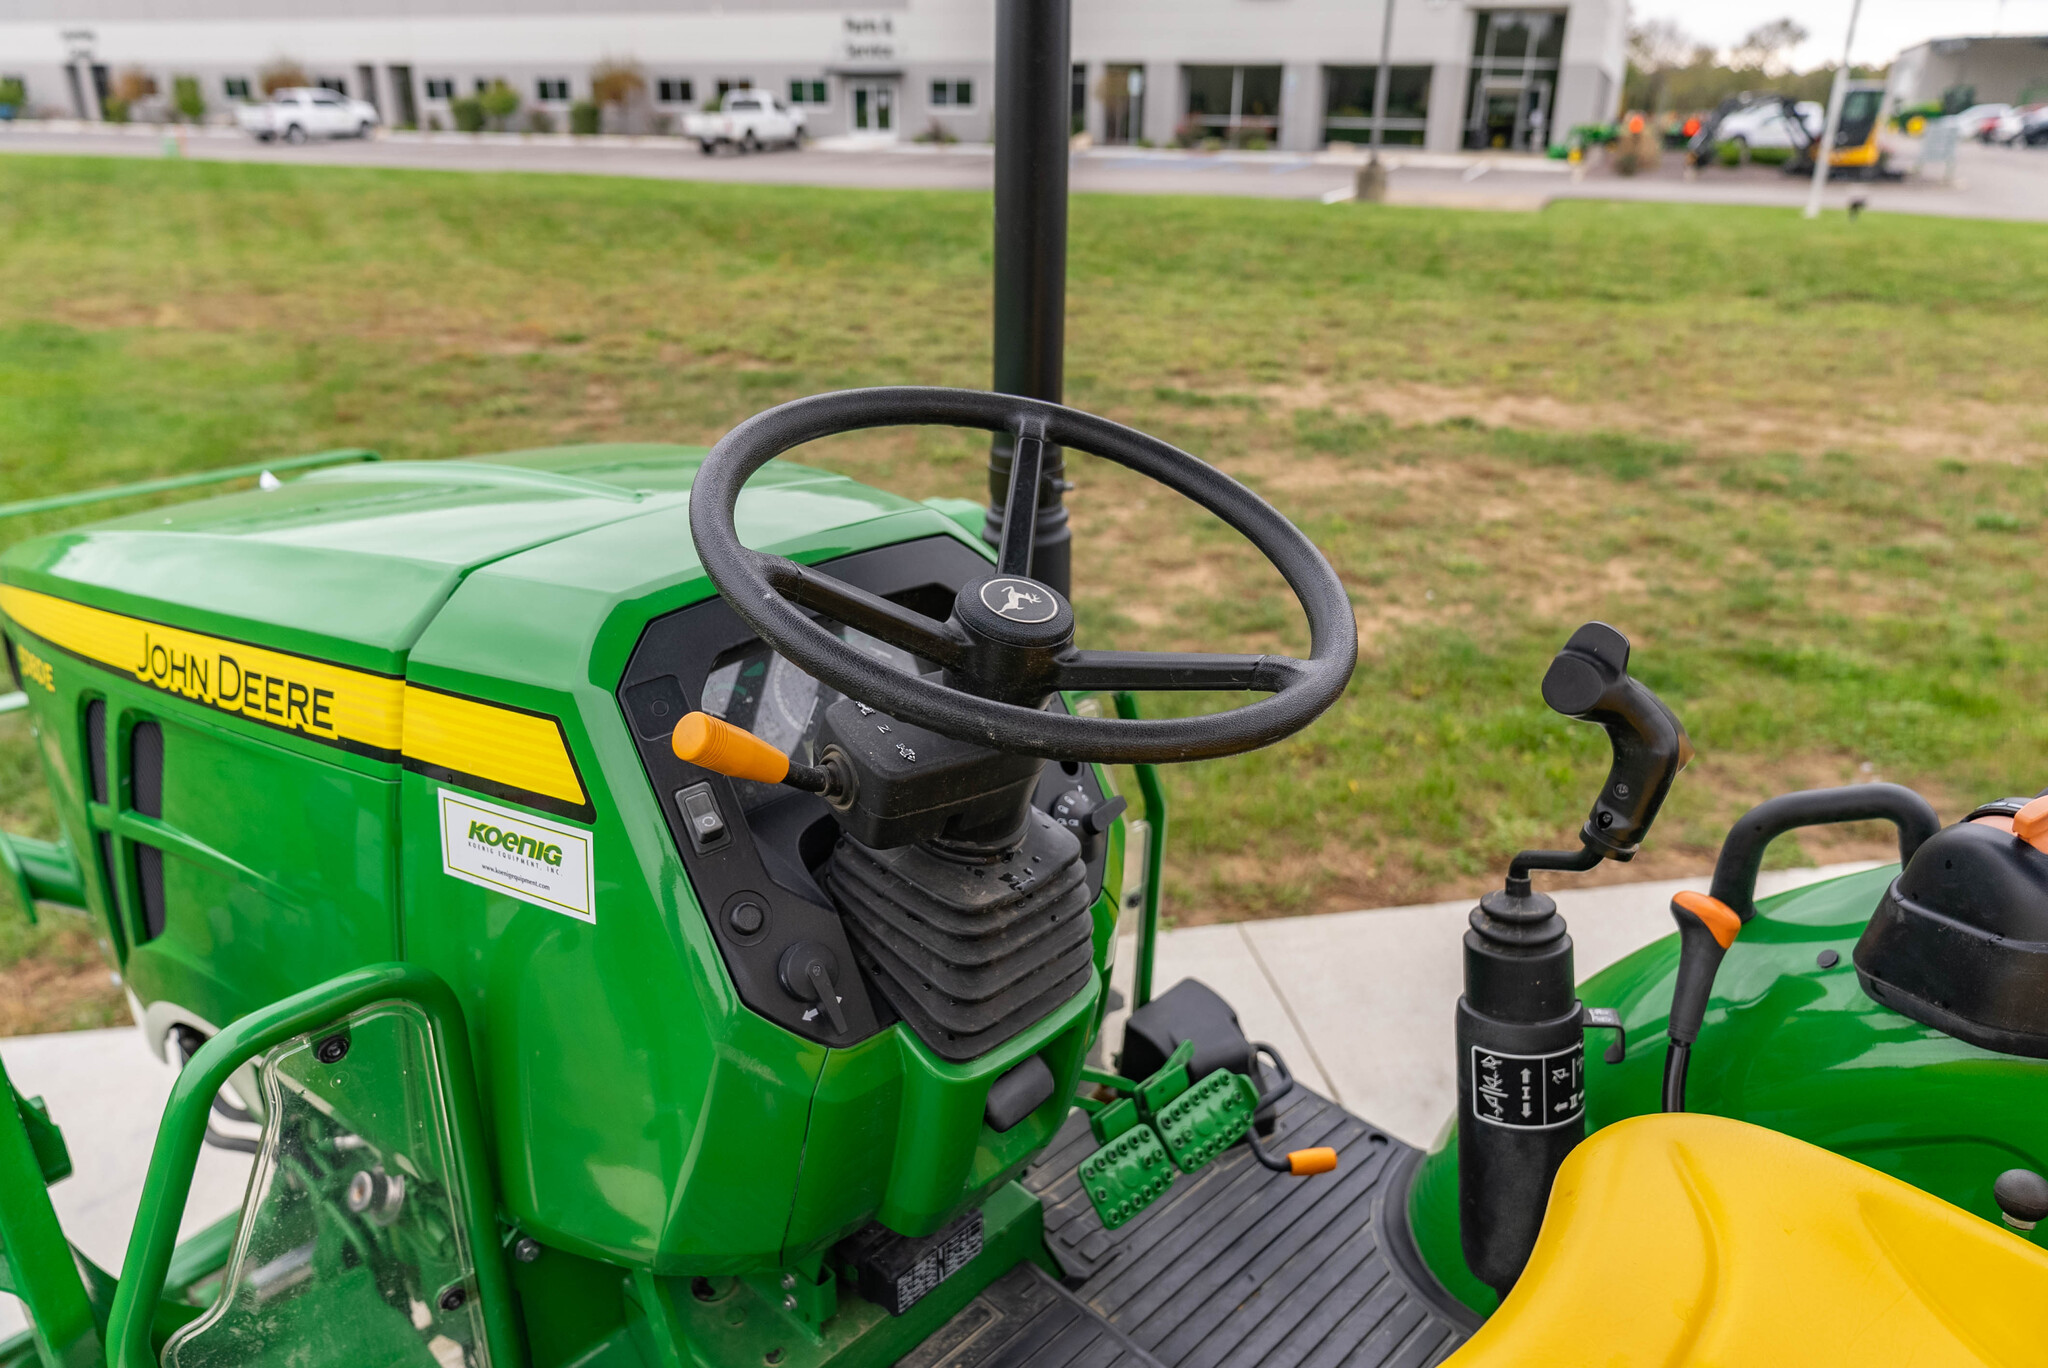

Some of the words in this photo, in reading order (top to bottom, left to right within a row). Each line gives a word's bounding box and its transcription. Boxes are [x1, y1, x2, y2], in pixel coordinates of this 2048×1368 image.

[137, 632, 208, 695] JOHN
[218, 654, 335, 731] DEERE
[468, 841, 495, 854] KOENIG
[481, 863, 551, 891] www.koenigequipment.com
